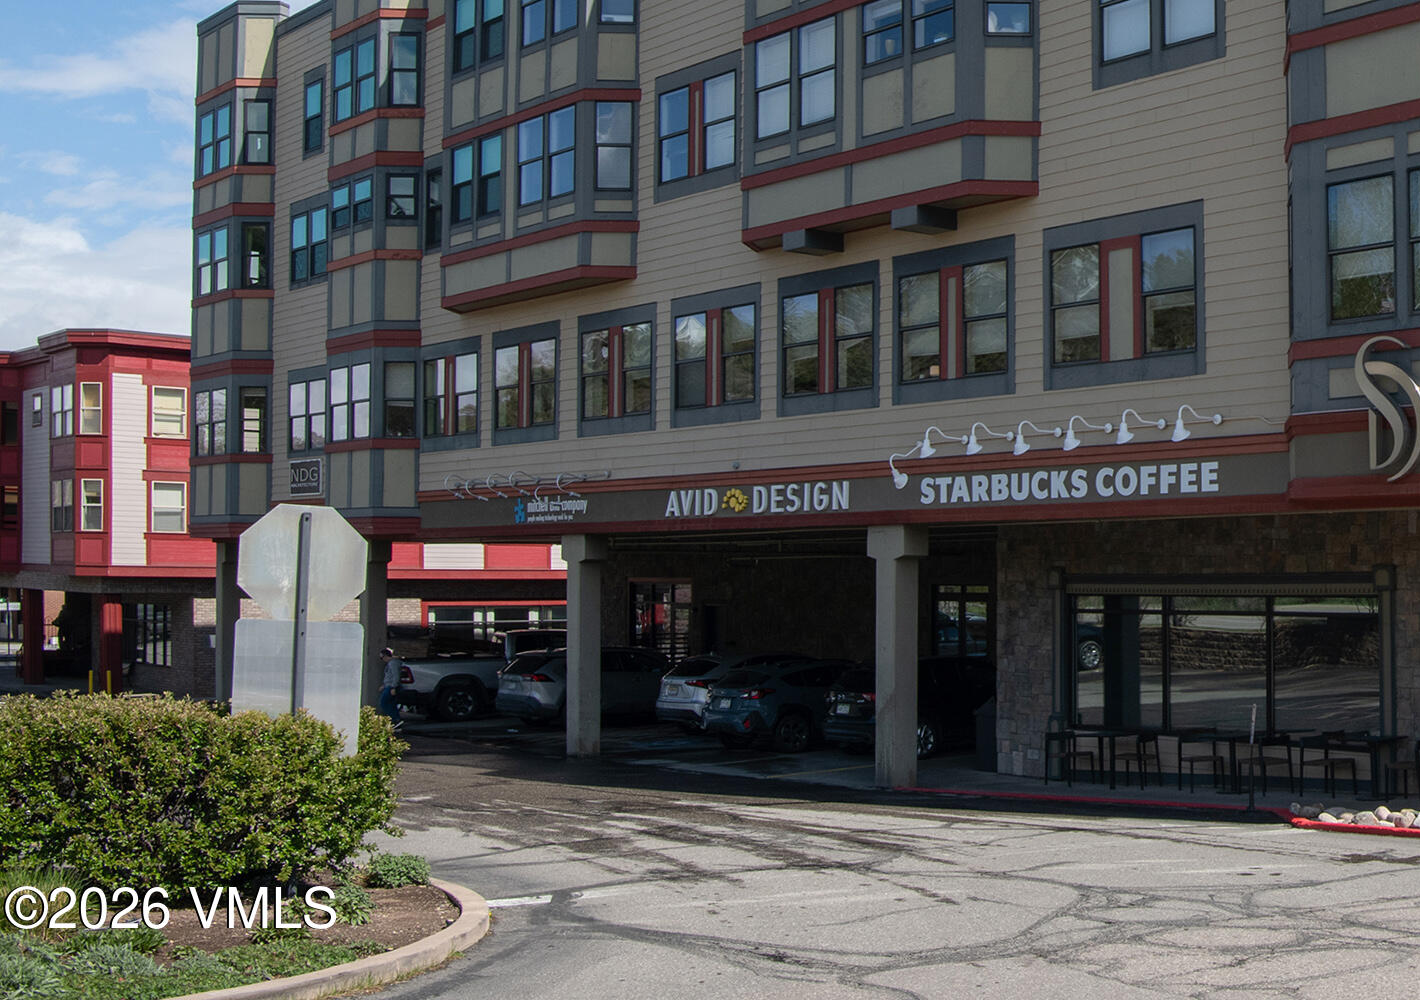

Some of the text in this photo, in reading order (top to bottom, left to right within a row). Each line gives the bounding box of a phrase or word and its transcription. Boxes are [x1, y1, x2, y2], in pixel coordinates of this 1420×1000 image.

[290, 467, 319, 482] NDG
[920, 461, 1219, 505] STARBUCKS COFFEE
[561, 500, 588, 514] company
[665, 480, 850, 518] AVID DESIGN
